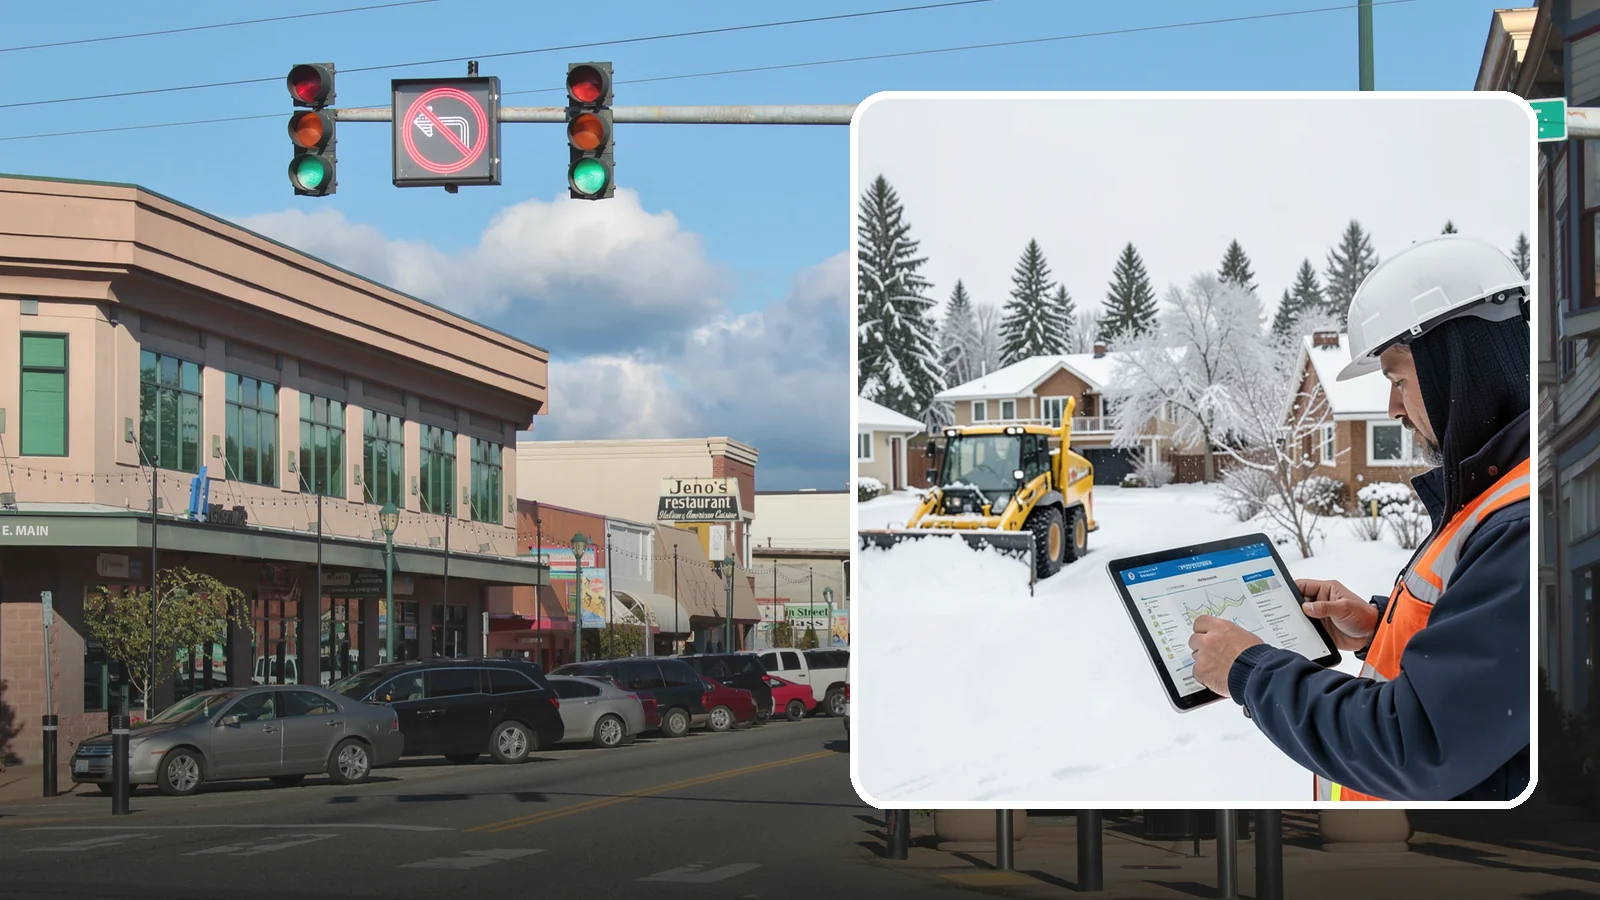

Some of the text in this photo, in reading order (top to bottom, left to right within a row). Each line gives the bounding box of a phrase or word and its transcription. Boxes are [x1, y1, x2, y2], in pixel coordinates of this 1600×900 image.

[669, 480, 728, 494] Jeno's
[665, 496, 731, 509] restaurant
[658, 510, 682, 520] Italian
[686, 509, 714, 519] American
[715, 509, 737, 519] Cuisine
[2, 525, 49, 536] E. MAIN
[797, 607, 828, 616] Street
